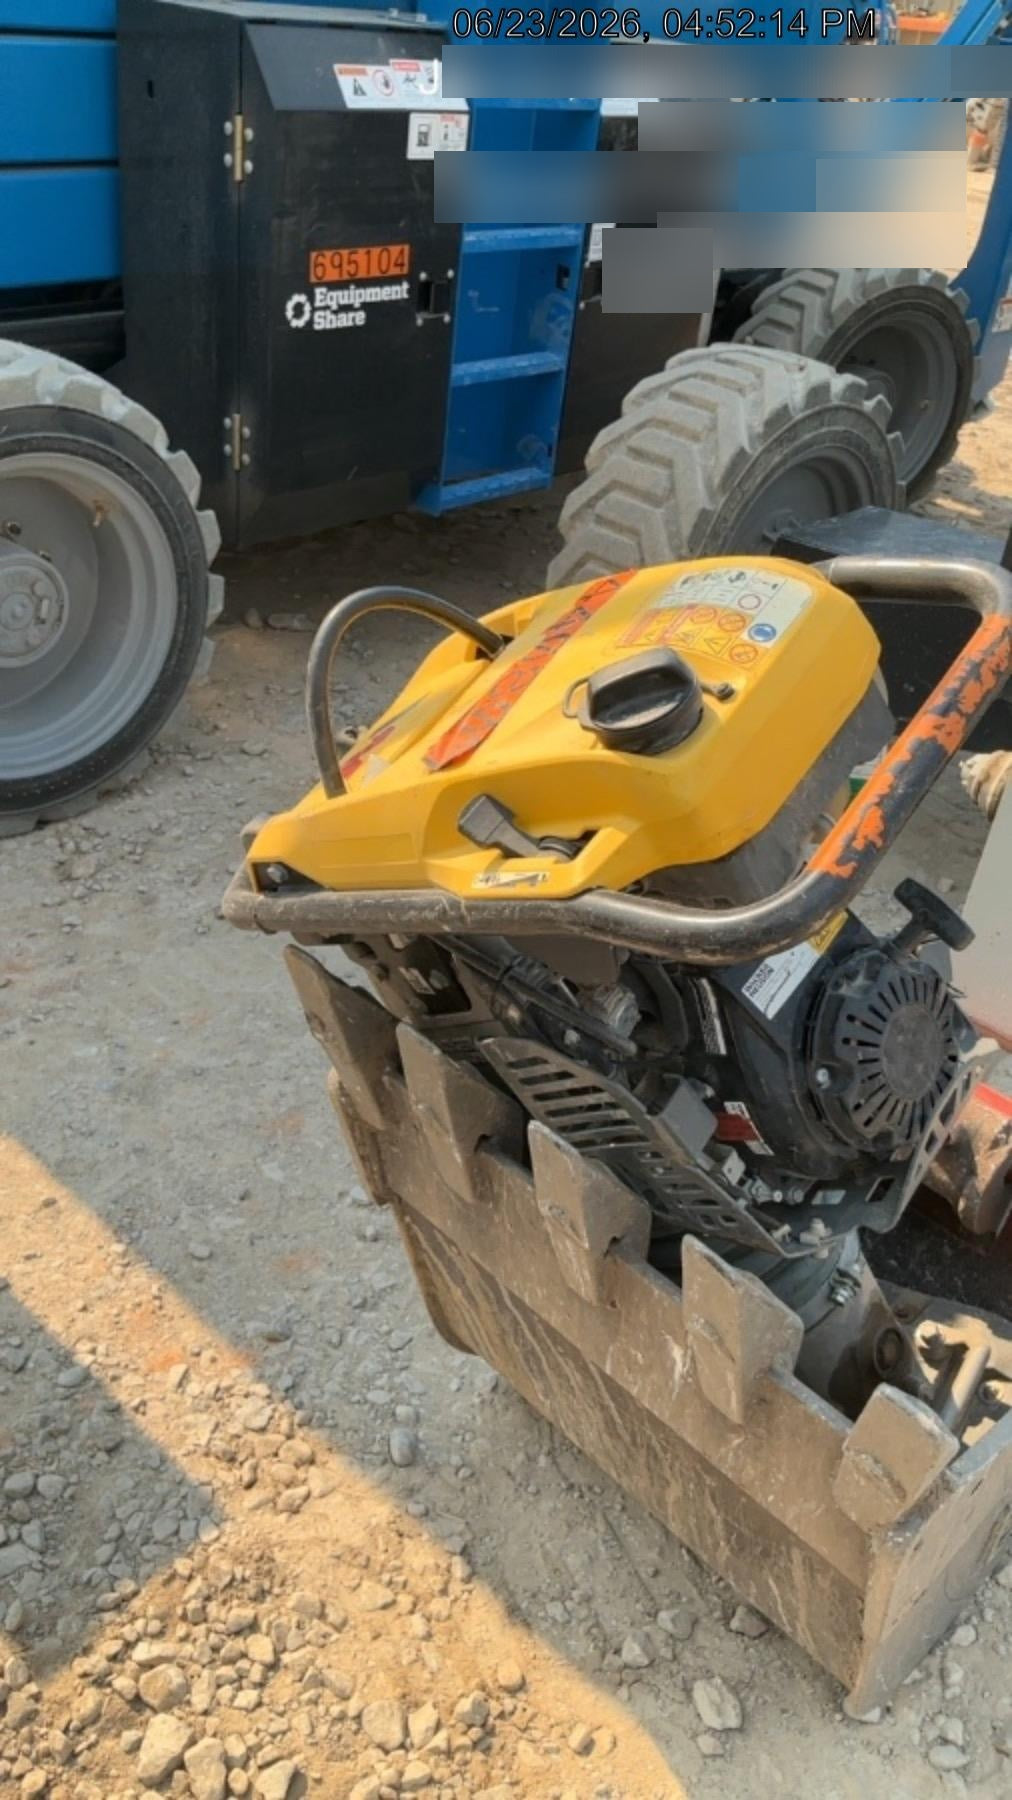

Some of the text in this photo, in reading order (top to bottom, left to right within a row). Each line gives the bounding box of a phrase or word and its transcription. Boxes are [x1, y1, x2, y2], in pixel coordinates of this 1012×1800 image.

[313, 246, 406, 281] 695104
[314, 280, 410, 311] Equipment
[313, 309, 367, 330] Share
